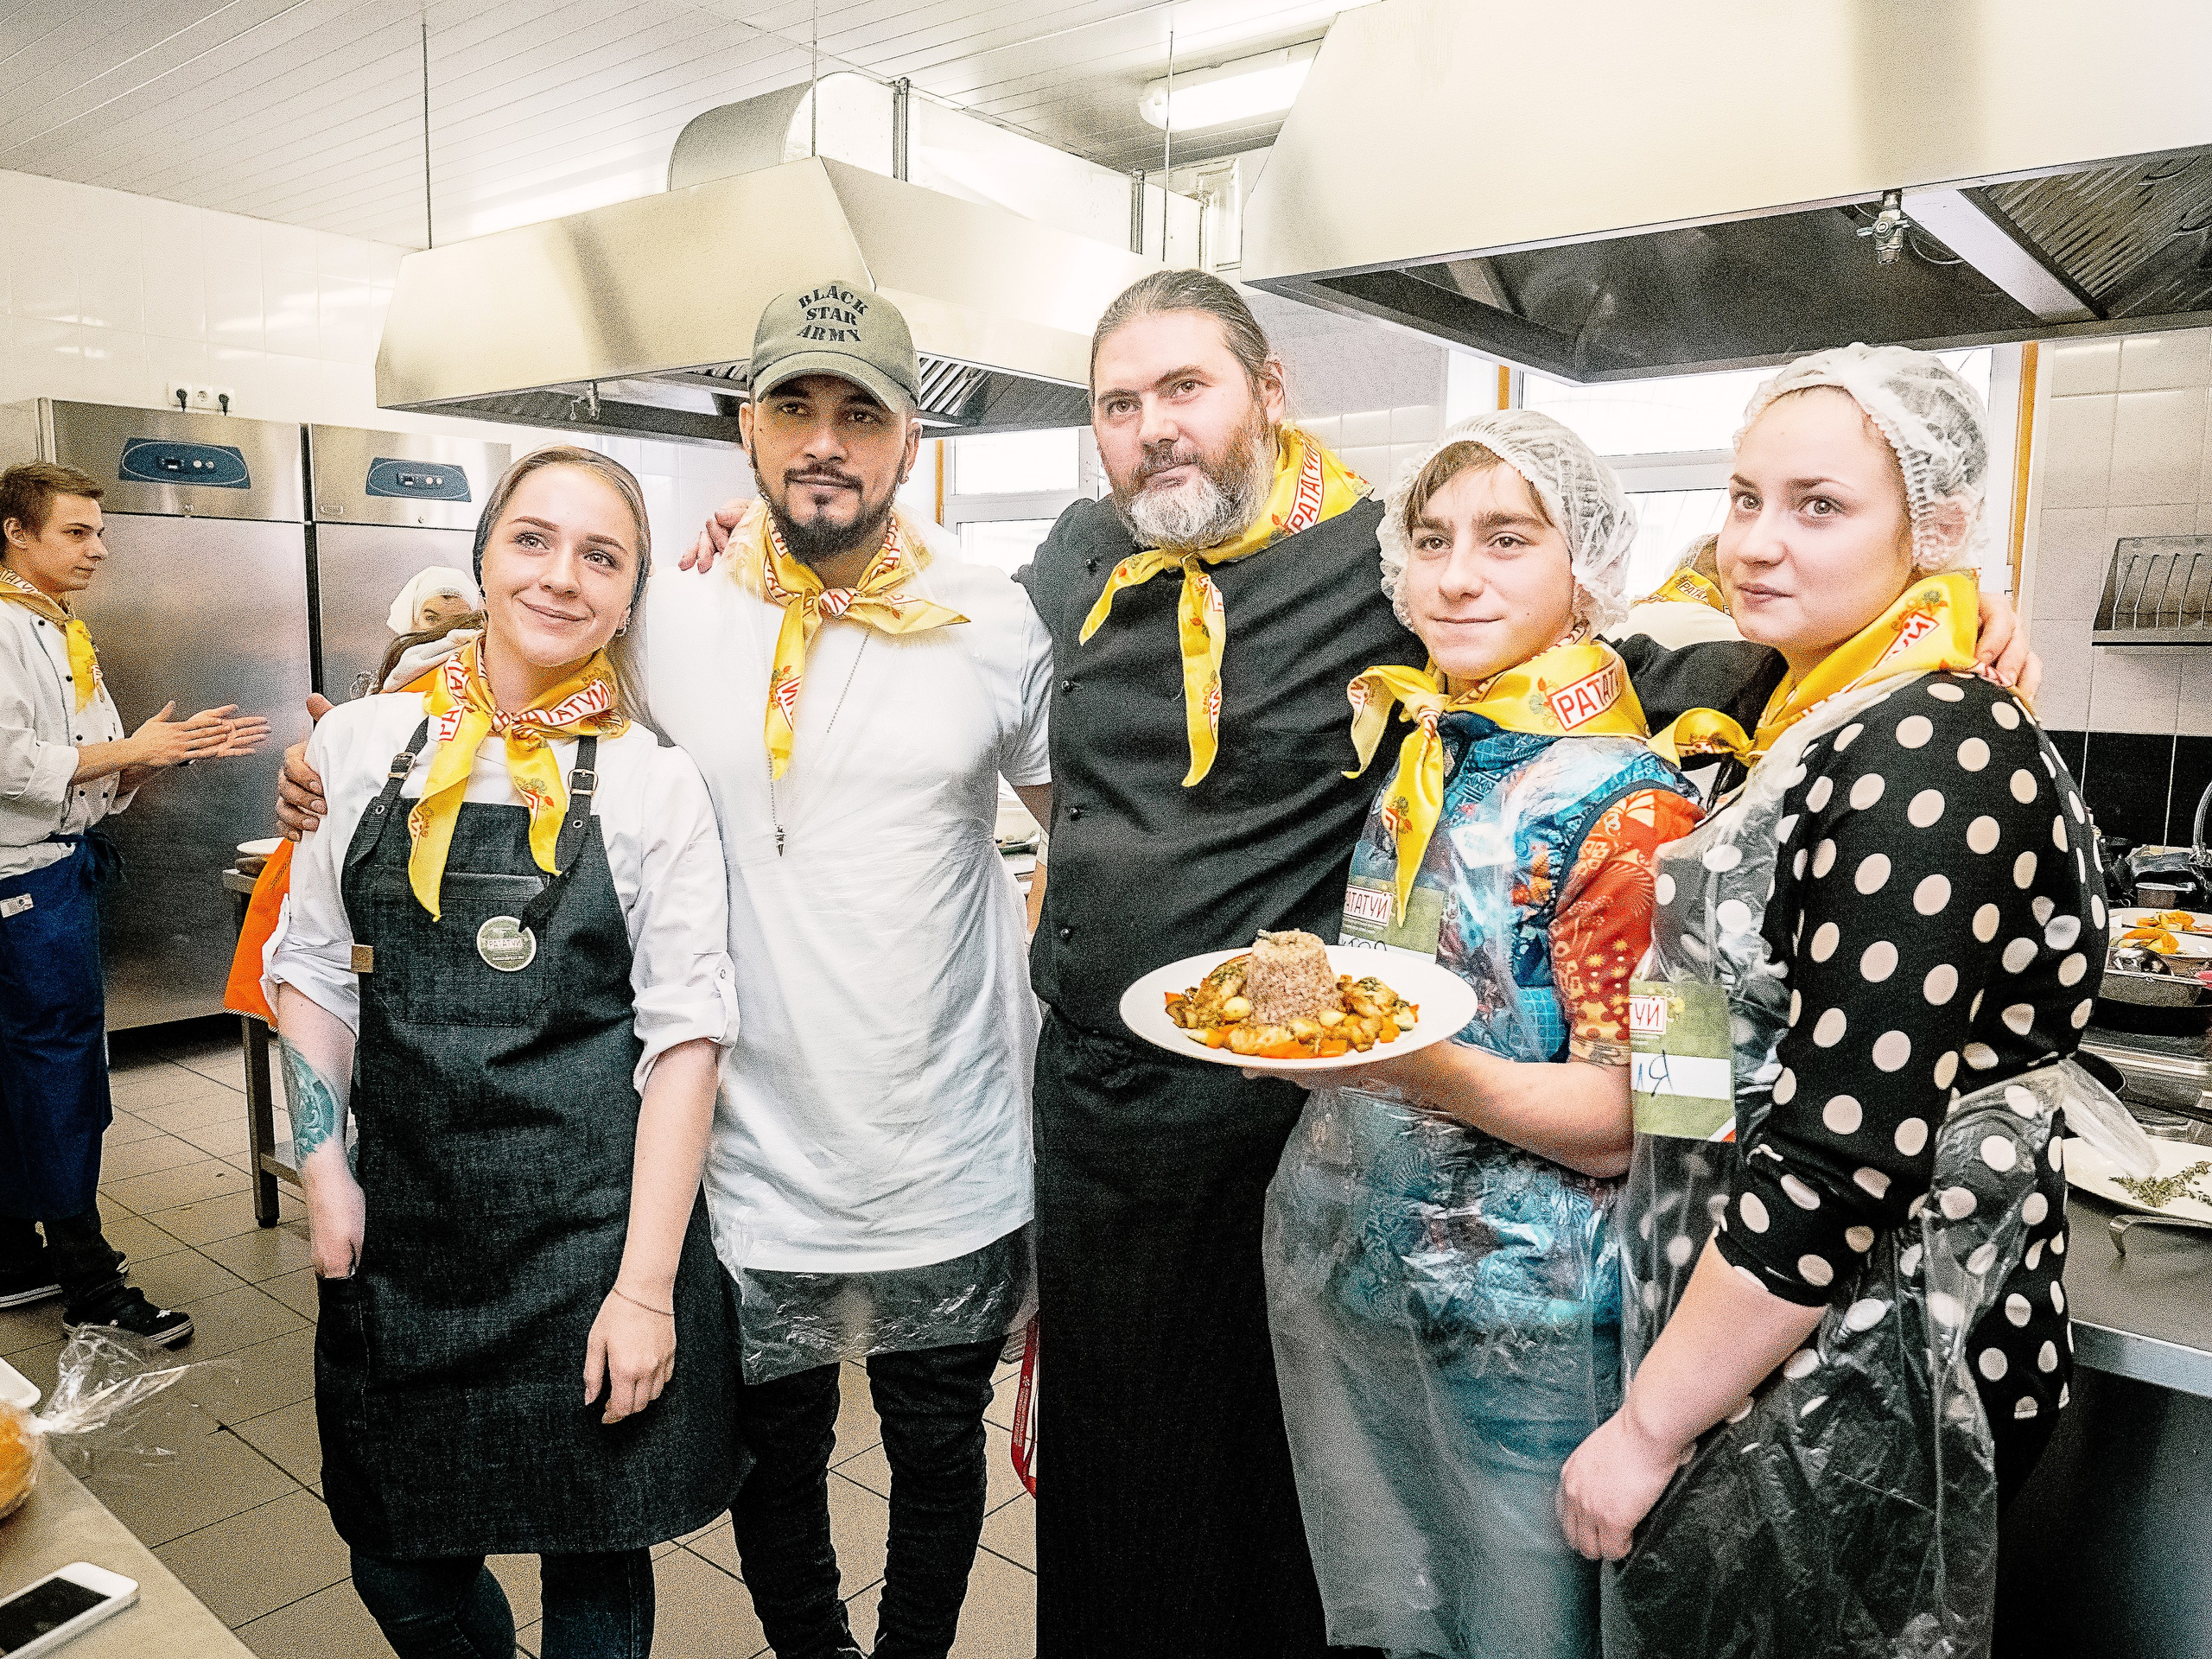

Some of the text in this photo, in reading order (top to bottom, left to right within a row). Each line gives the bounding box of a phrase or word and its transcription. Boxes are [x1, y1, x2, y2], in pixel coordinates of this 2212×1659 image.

[798, 285, 868, 315] BLACK
[806, 307, 857, 325] STAR
[797, 324, 861, 342] ARMY
[1556, 668, 1618, 724] РАТАТ
[1345, 891, 1389, 919] АТАТУЙ
